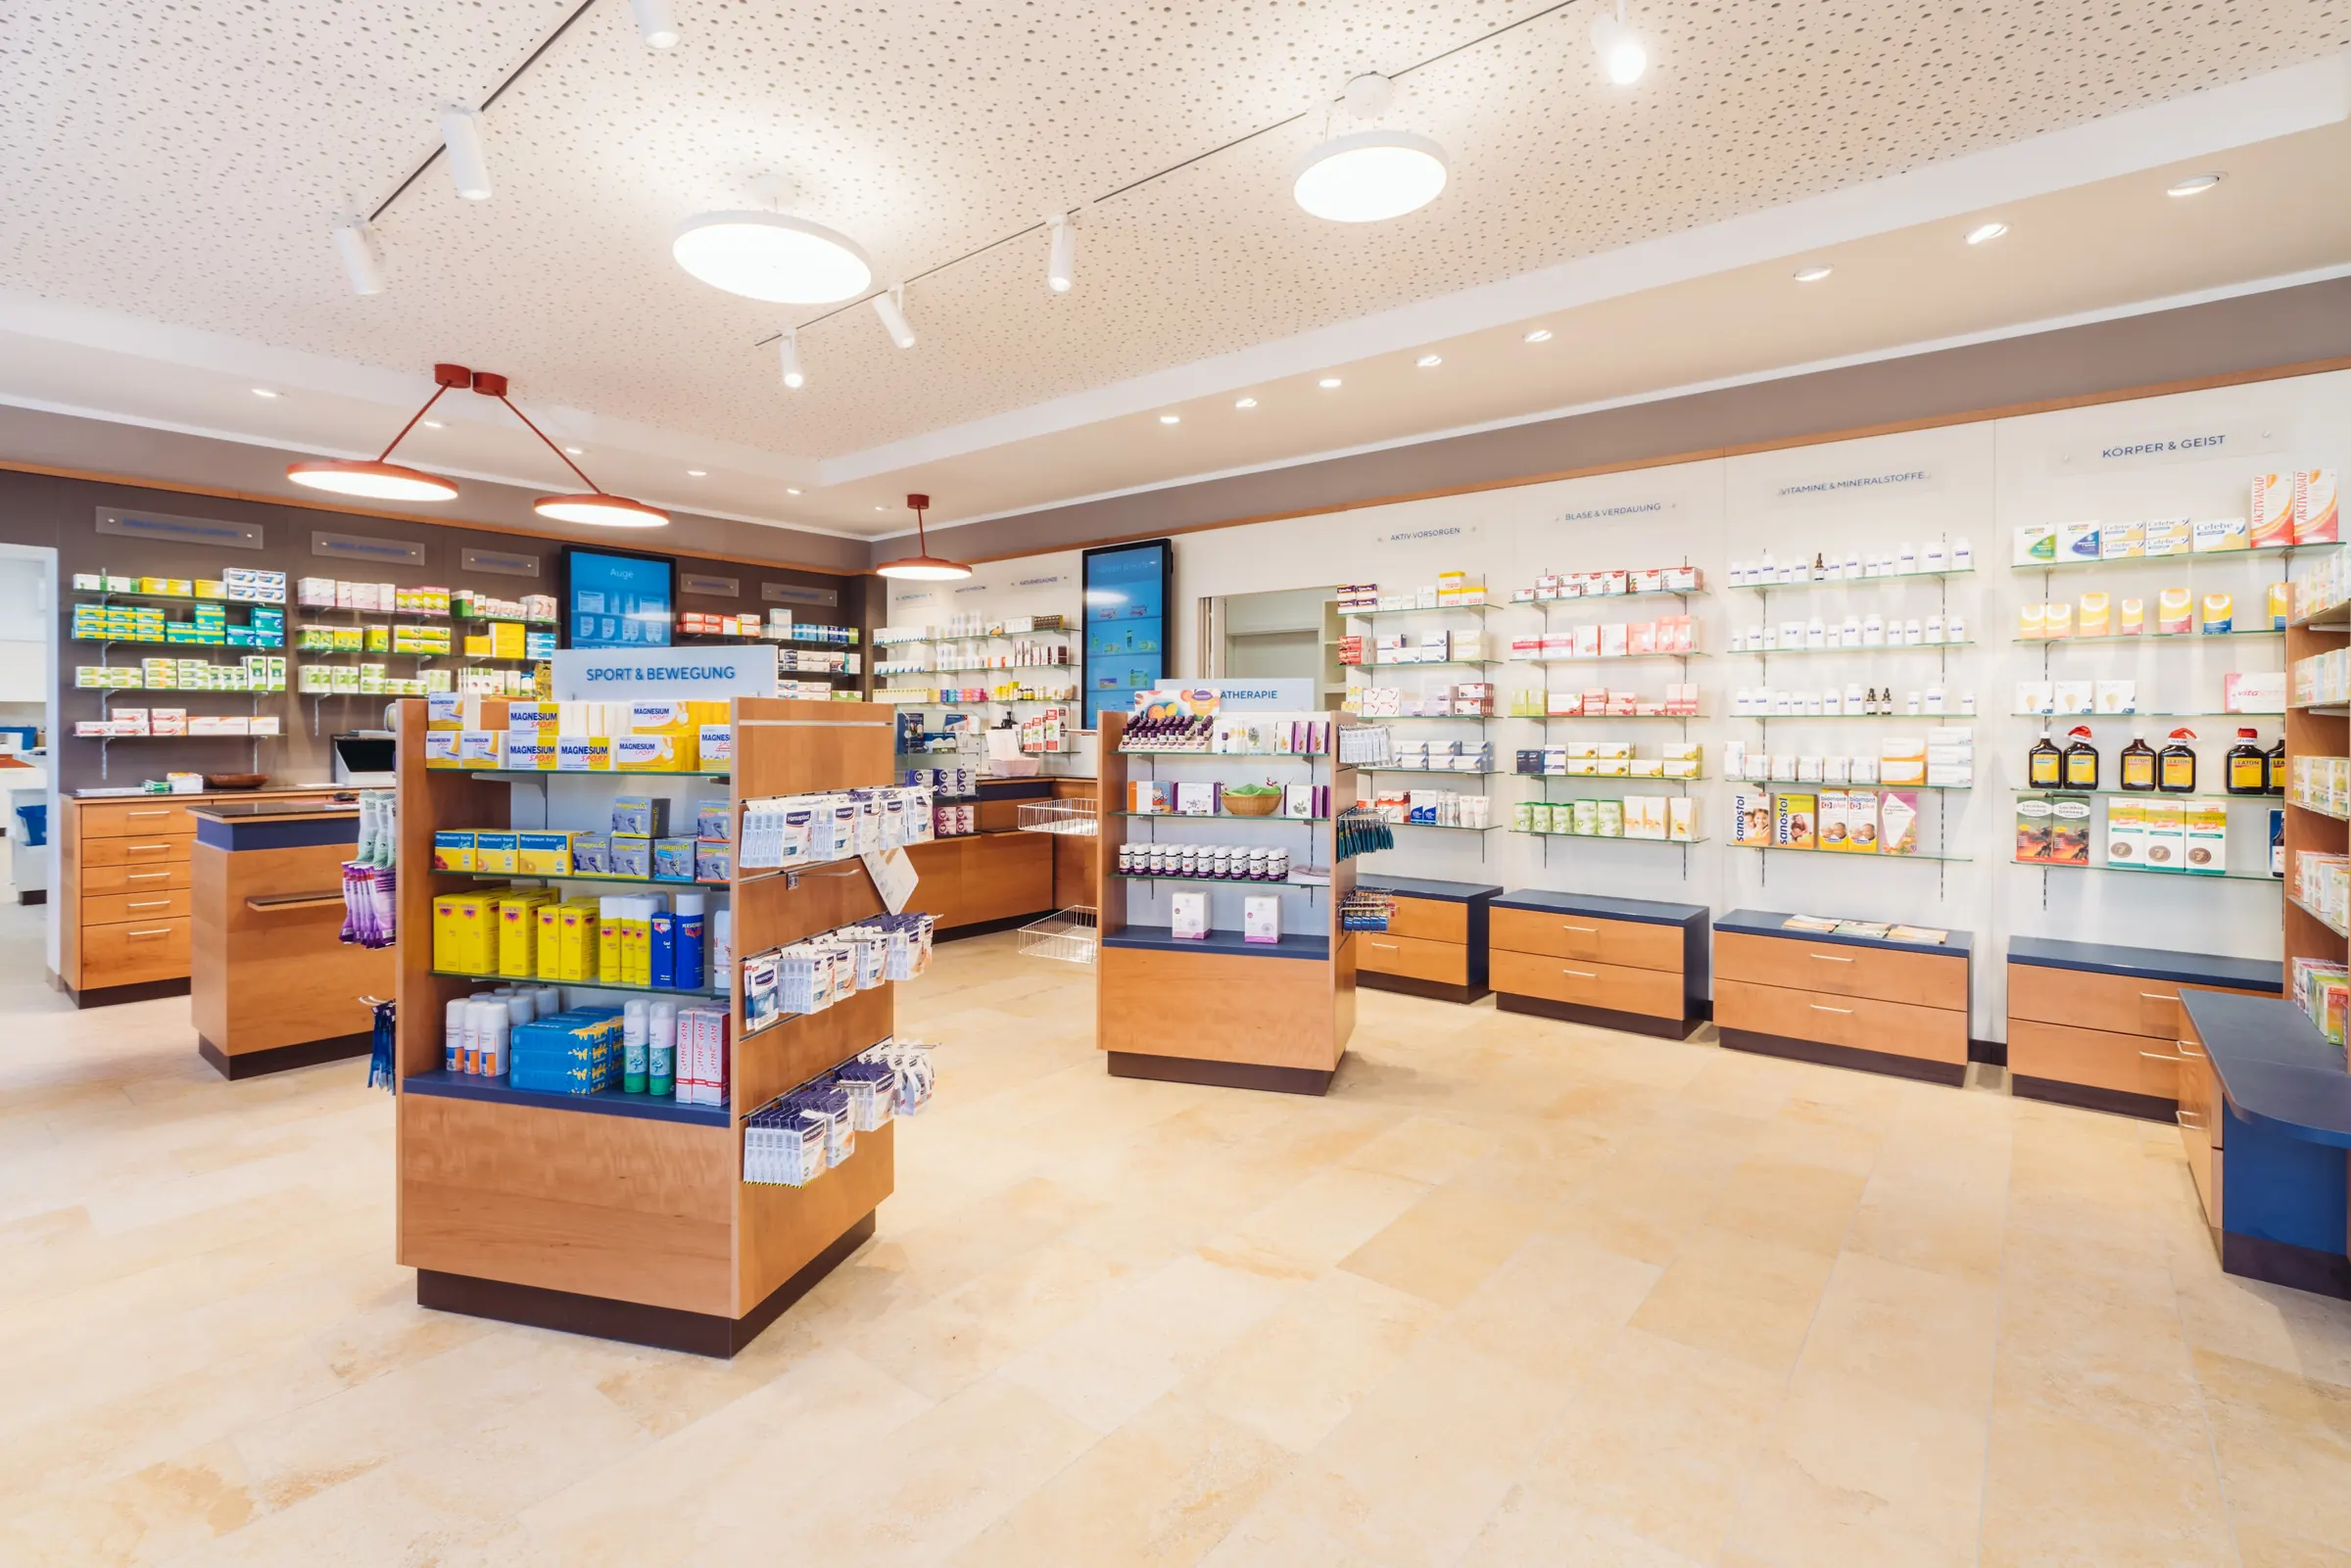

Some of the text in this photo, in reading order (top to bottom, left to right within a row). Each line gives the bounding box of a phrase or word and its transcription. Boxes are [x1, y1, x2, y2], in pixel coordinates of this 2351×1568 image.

[2102, 434, 2226, 458] KÖRPER & GEIST
[1780, 483, 1827, 496] VITAMINE
[1837, 471, 1924, 489] MINERALSTOFFE
[1565, 510, 1593, 521] BLASE
[1602, 502, 1661, 516] VERDAUUNG
[1413, 527, 1461, 539] VORSORGEN
[586, 666, 736, 682] SPORT & BEWEGUNG
[1220, 689, 1278, 699] ATHERAPIE
[510, 712, 557, 721] MAGNESIUM
[510, 745, 555, 754] MAGNESIUM
[560, 746, 608, 755] MAGNESIUM
[1736, 795, 1746, 842] sanostol
[1779, 797, 1789, 845] sanostol
